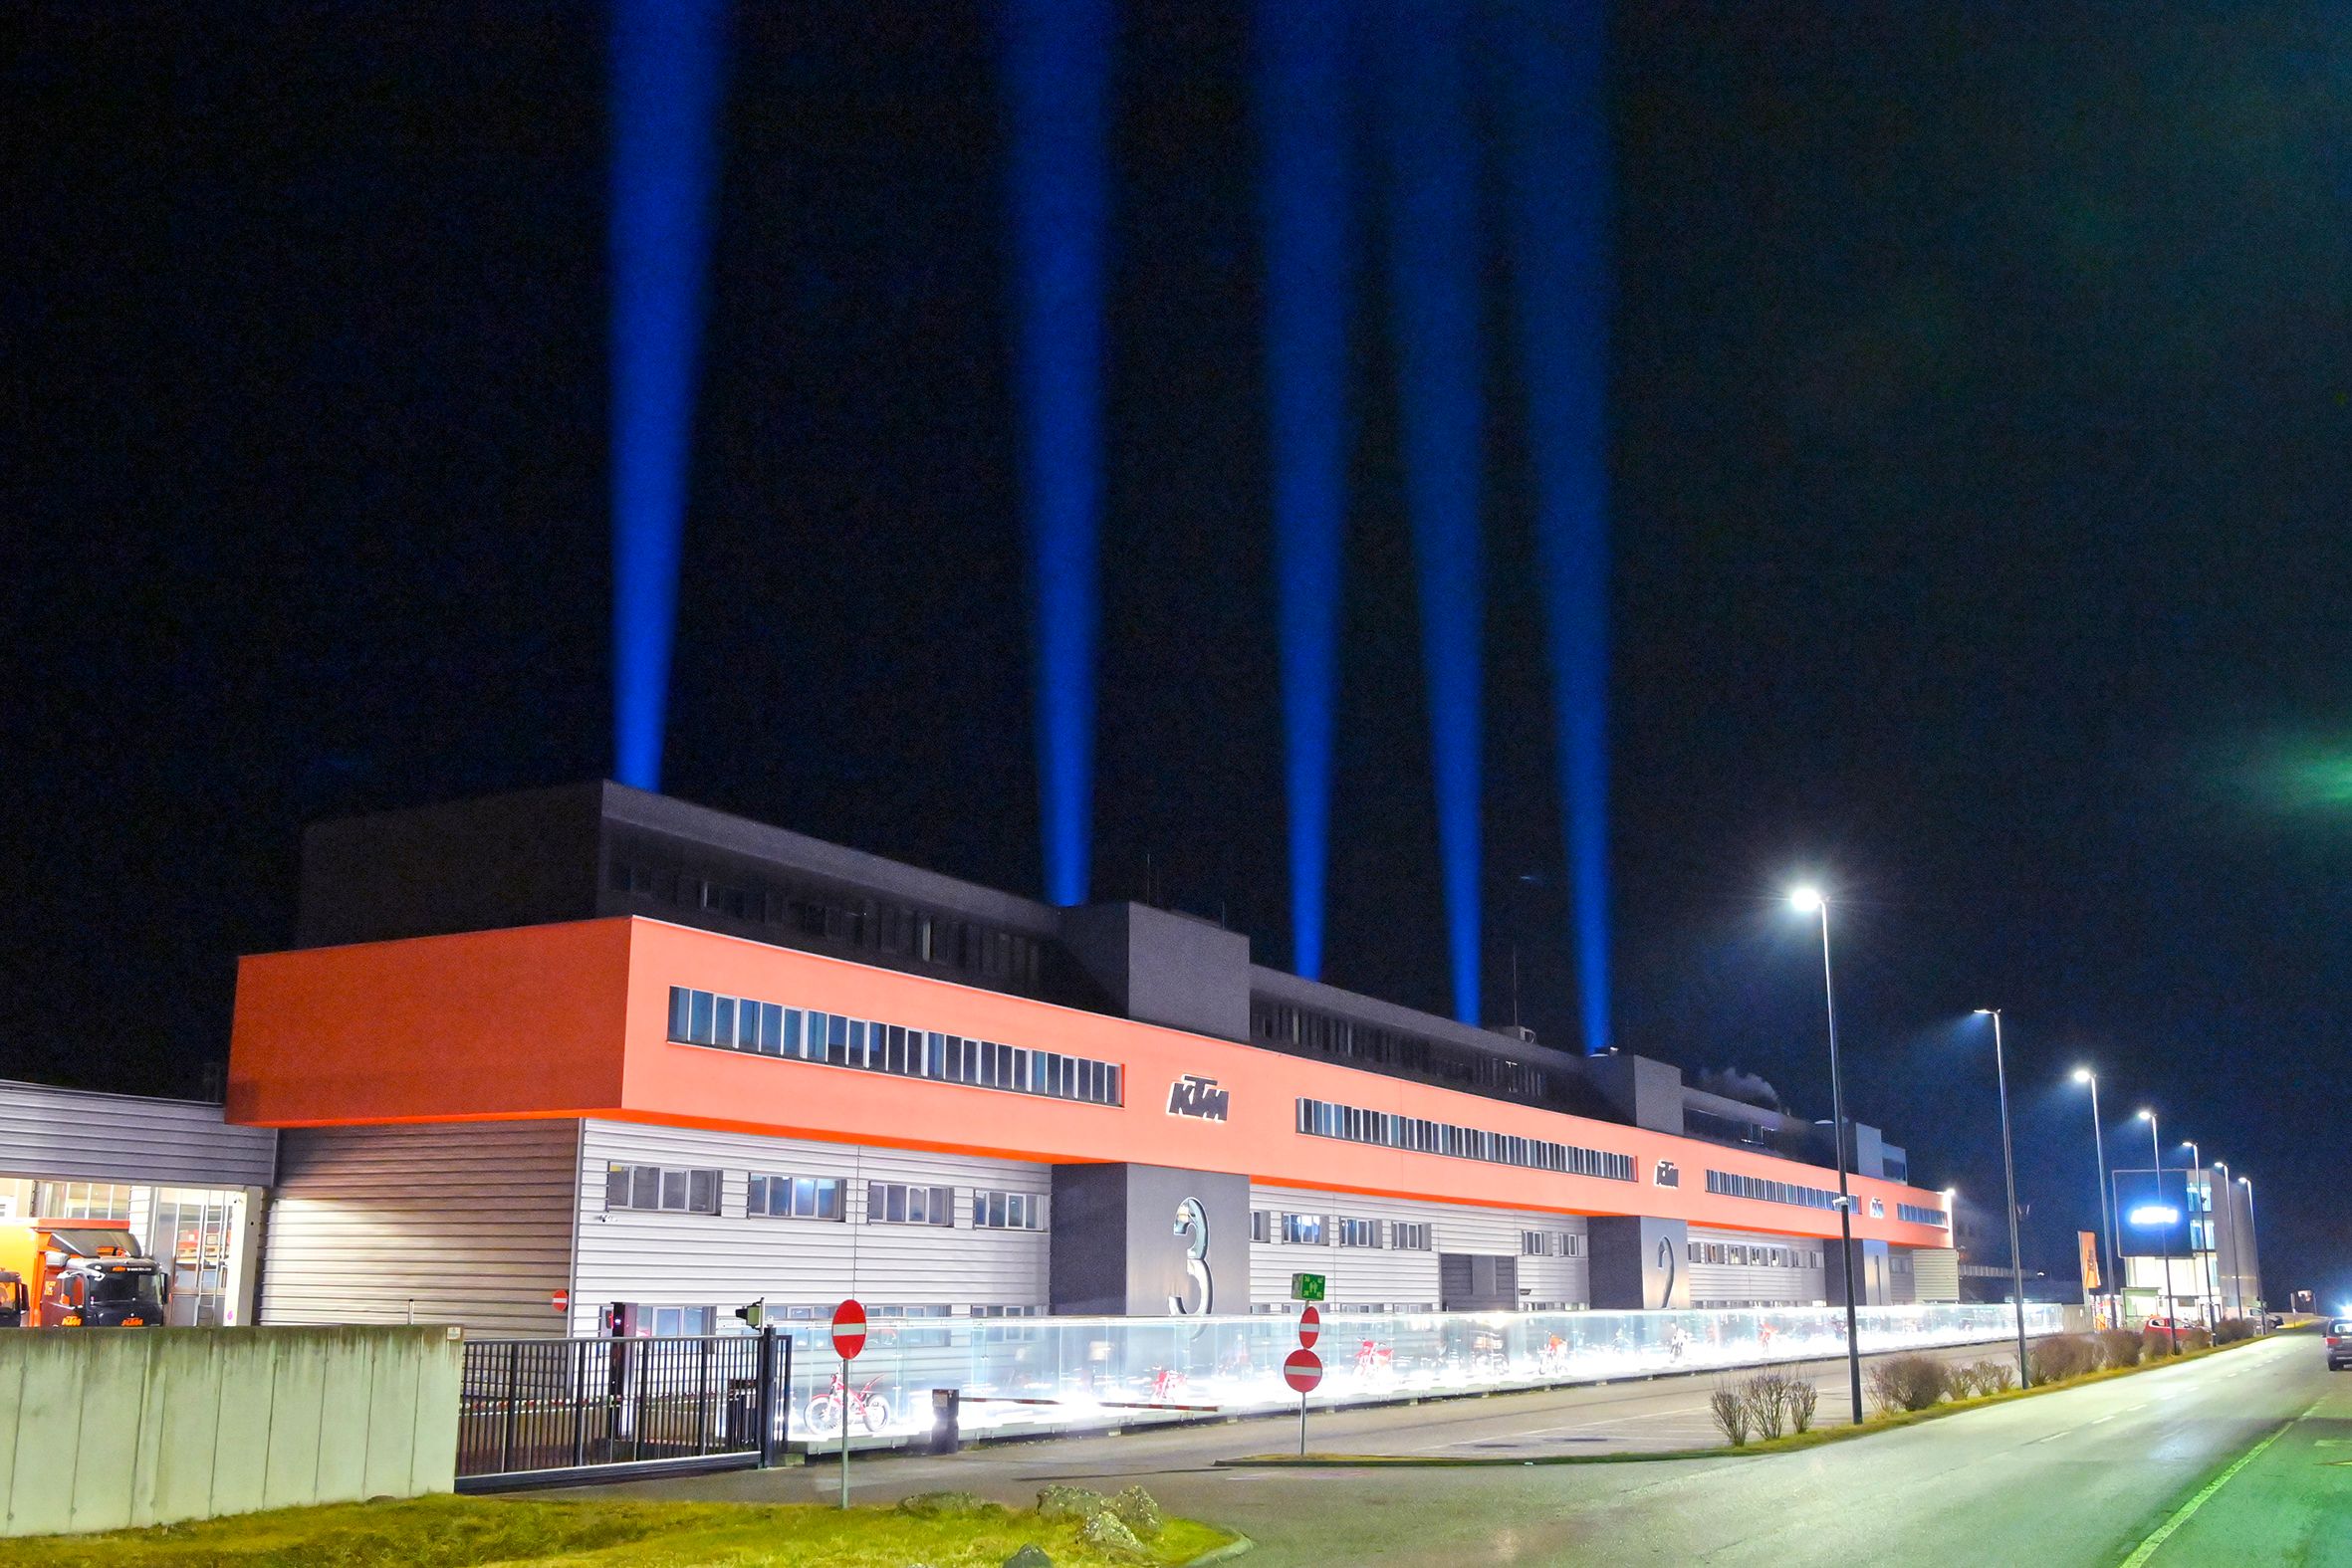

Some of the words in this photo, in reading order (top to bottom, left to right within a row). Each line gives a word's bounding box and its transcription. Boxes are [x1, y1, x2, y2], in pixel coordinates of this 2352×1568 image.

[1169, 1074, 1230, 1122] KTM
[1168, 1197, 1214, 1340] 3
[61, 1315, 82, 1326] KTM
[121, 1317, 143, 1326] KTM
